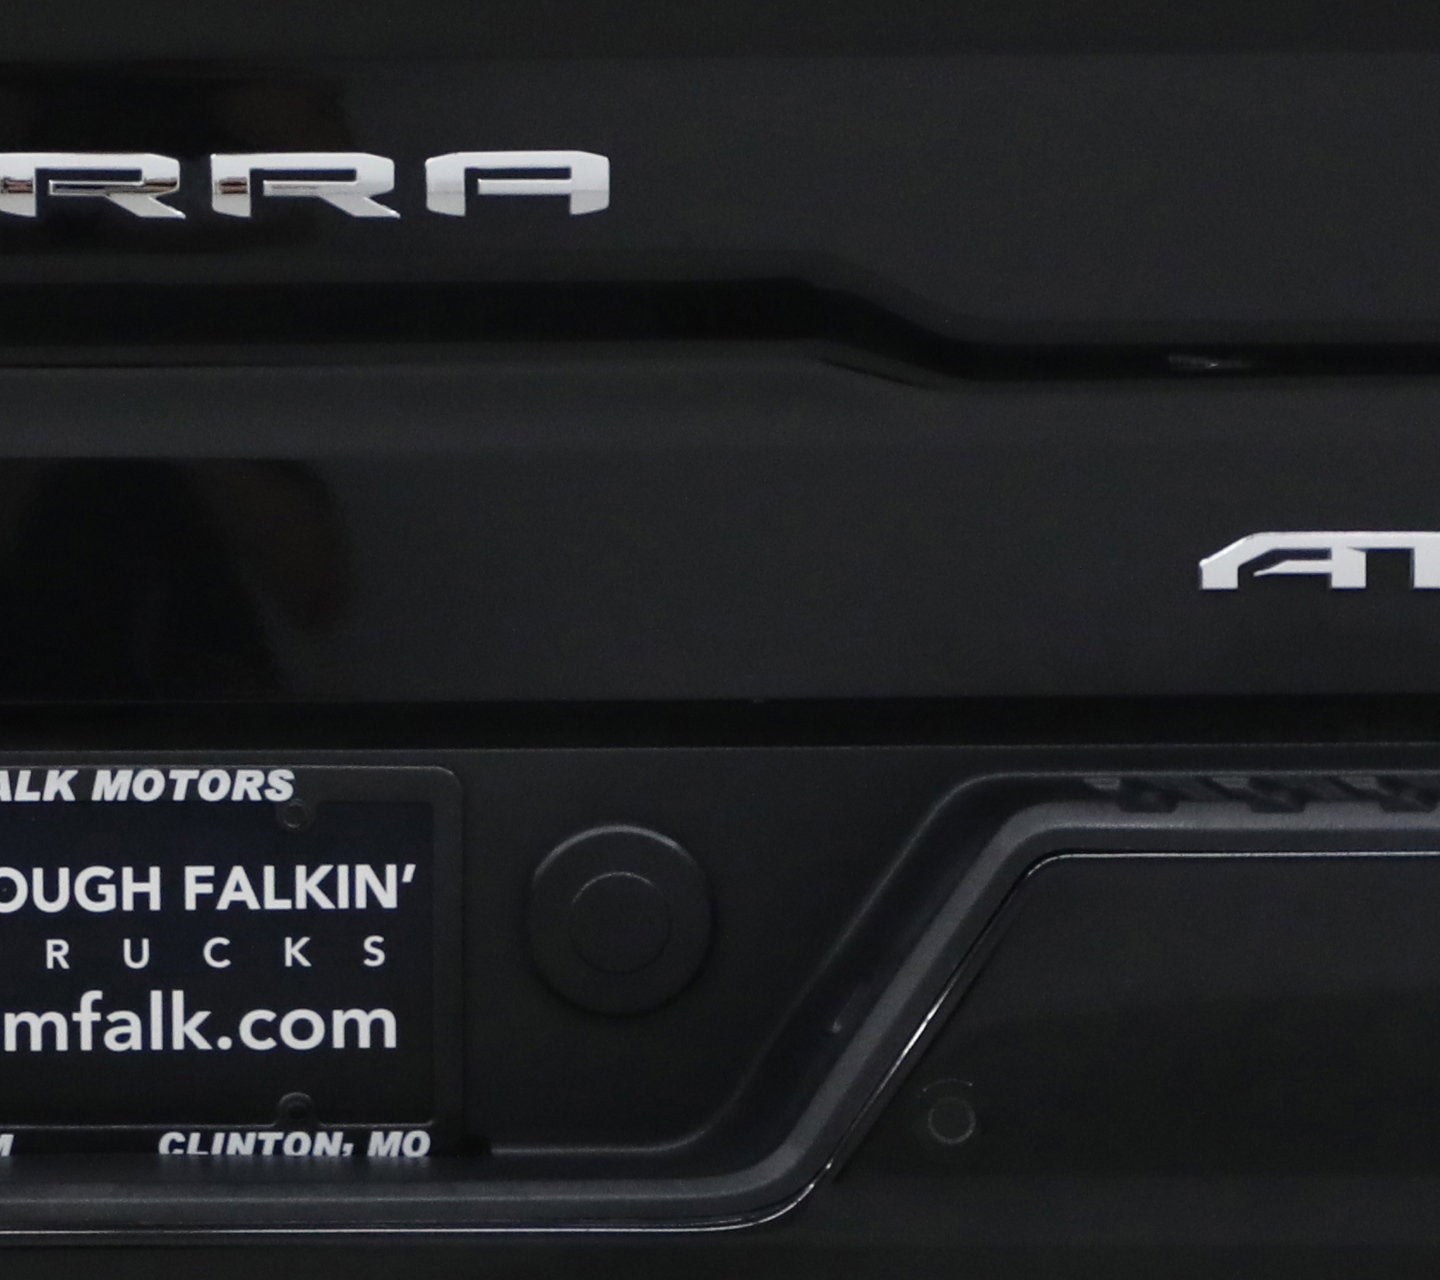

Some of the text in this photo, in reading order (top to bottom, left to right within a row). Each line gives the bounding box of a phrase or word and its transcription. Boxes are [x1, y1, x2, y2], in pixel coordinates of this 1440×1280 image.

[91, 768, 296, 803] MOTORS
[184, 863, 417, 912] FALKIN'
[158, 1130, 432, 1158] CLINTON, MO
